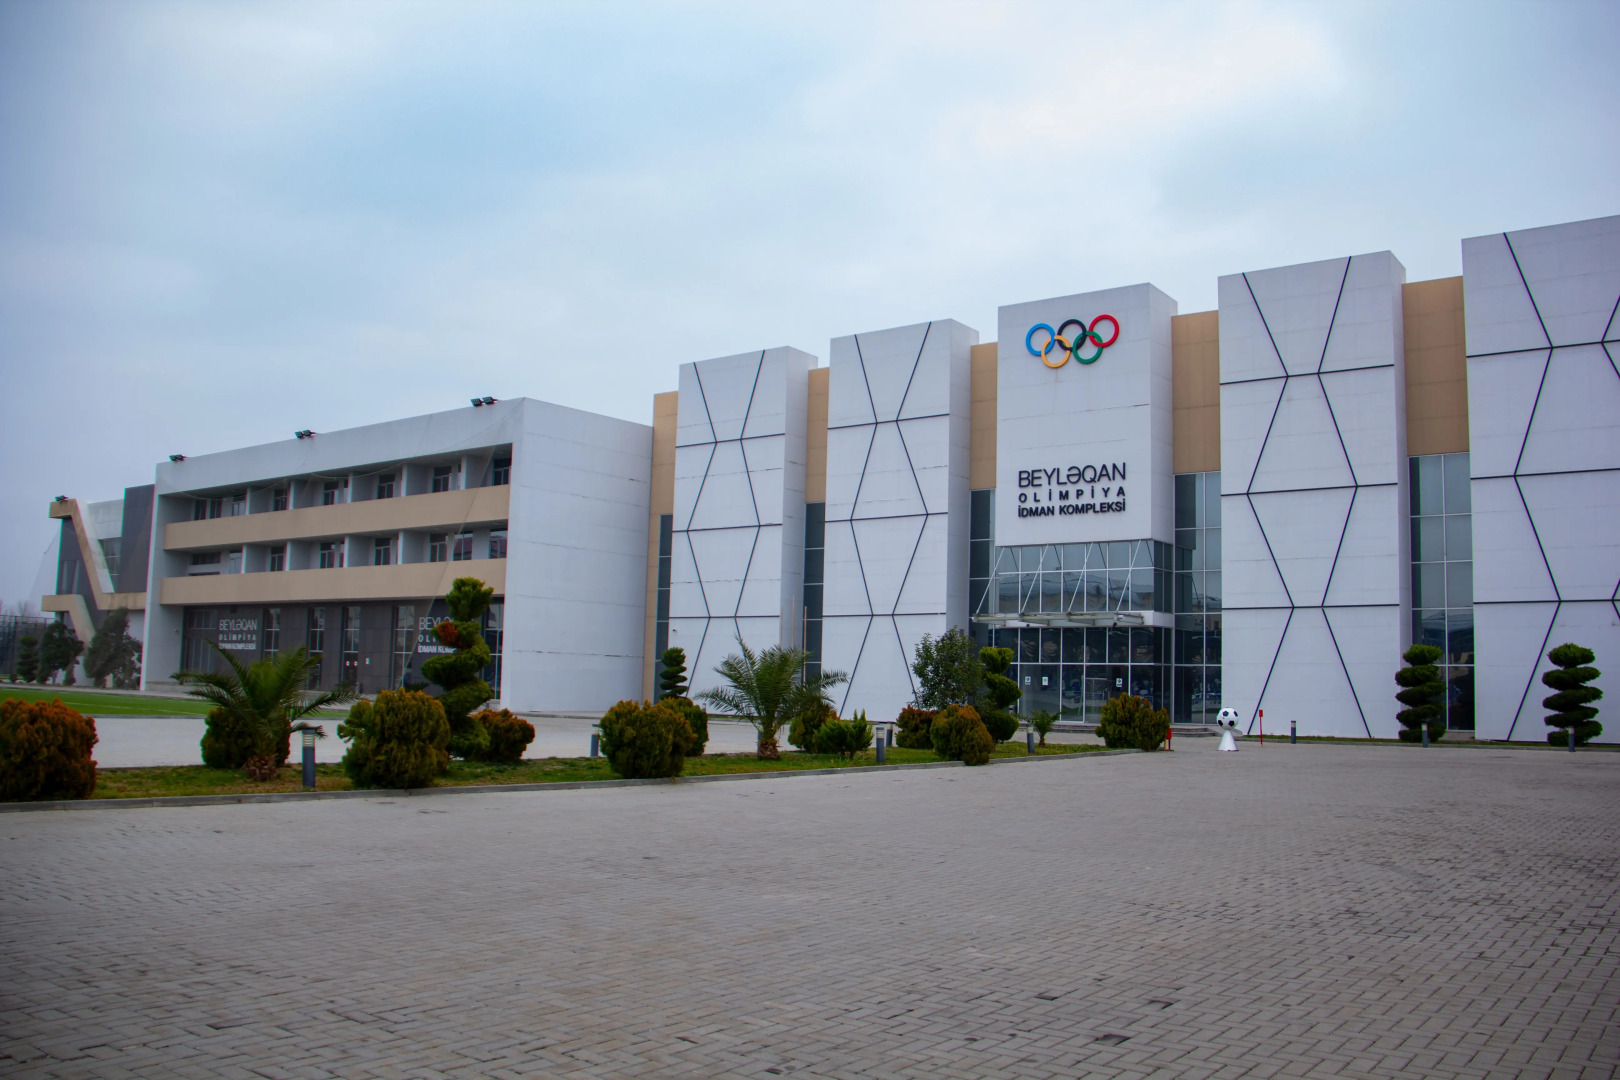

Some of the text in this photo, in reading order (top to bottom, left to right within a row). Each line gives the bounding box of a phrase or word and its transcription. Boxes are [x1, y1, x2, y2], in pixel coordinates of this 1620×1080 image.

[1018, 462, 1126, 488] BEYLƏQAN
[1018, 498, 1126, 518] İDMAN KOMPLEKSİ
